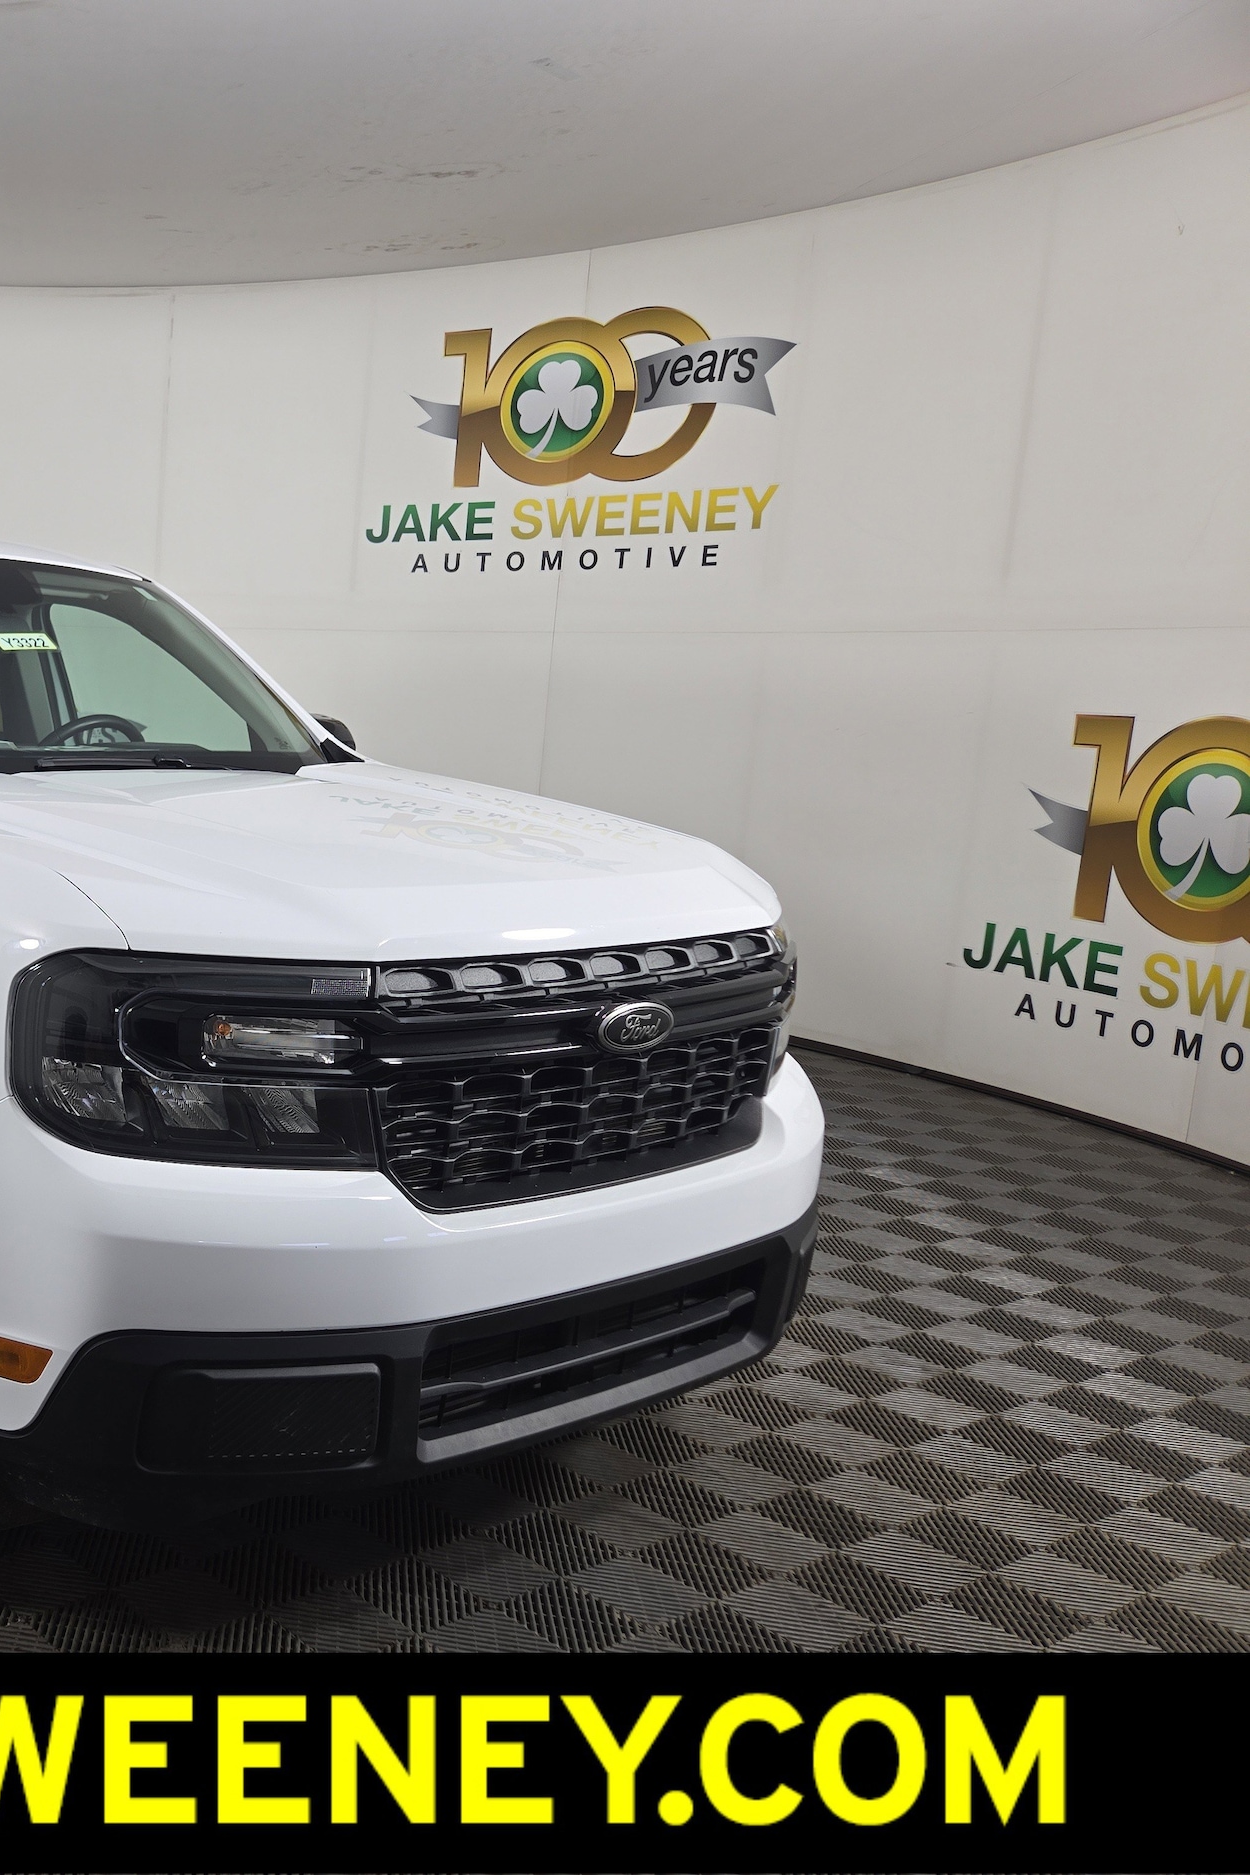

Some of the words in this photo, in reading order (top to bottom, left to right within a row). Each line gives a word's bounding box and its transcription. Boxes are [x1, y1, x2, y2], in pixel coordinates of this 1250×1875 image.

[644, 347, 758, 403] years
[365, 501, 496, 544] JAKE
[510, 484, 779, 540] SWEENEY
[411, 544, 719, 573] AUTOMOTIVE
[1, 638, 50, 648] Y3322
[963, 922, 1124, 997] JAKE
[620, 1013, 662, 1043] Ford
